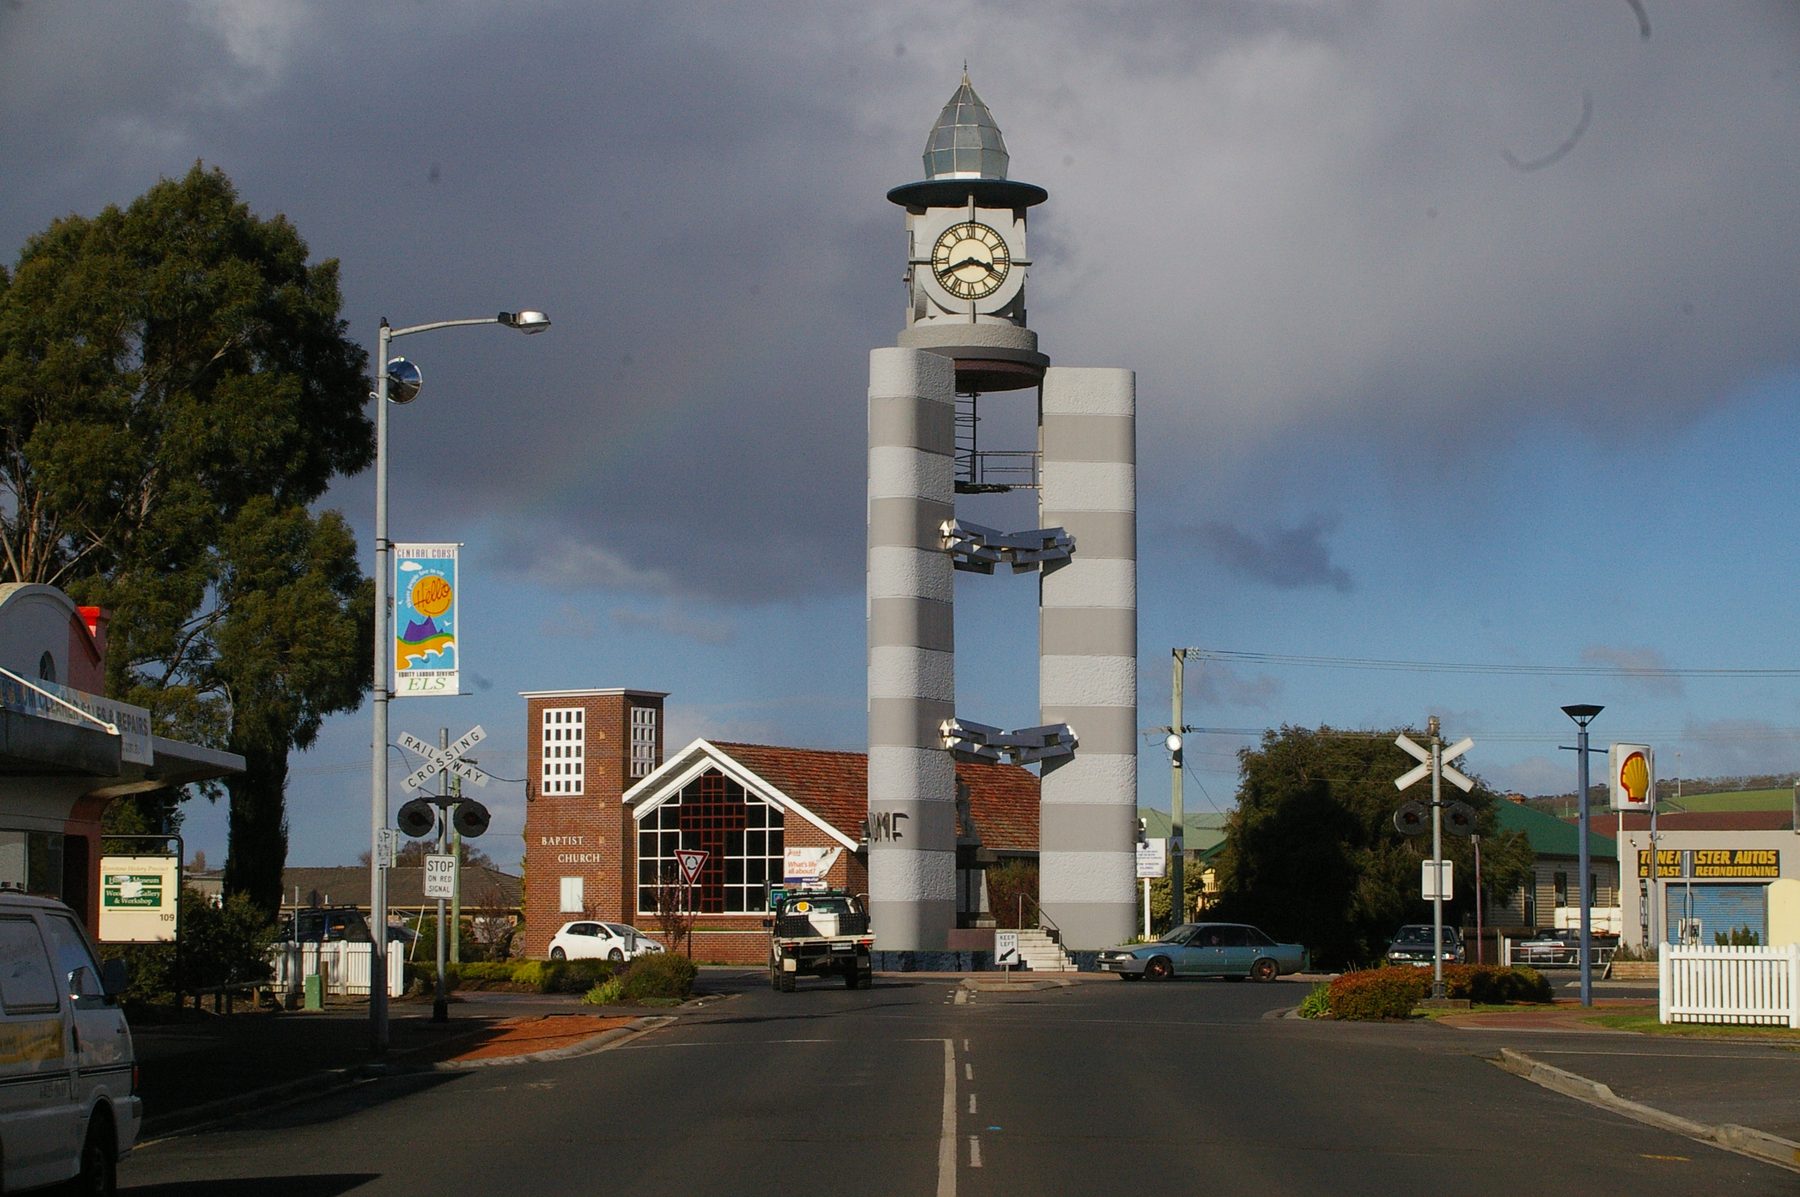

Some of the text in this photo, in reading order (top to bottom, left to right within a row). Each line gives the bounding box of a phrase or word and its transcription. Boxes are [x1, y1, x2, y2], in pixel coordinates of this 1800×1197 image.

[432, 549, 455, 558] COAST
[413, 578, 451, 608] Hello
[408, 677, 446, 690] ELS
[408, 730, 480, 788] CROSSING
[541, 836, 584, 846] BAPTIST
[557, 853, 600, 863] CHURCH
[1734, 850, 1776, 864] AUTOS
[427, 860, 454, 872] STOP
[1695, 866, 1778, 877] RECONDITIONING
[440, 875, 453, 883] RED
[428, 885, 451, 893] SIGNAL
[159, 913, 175, 922] 109
